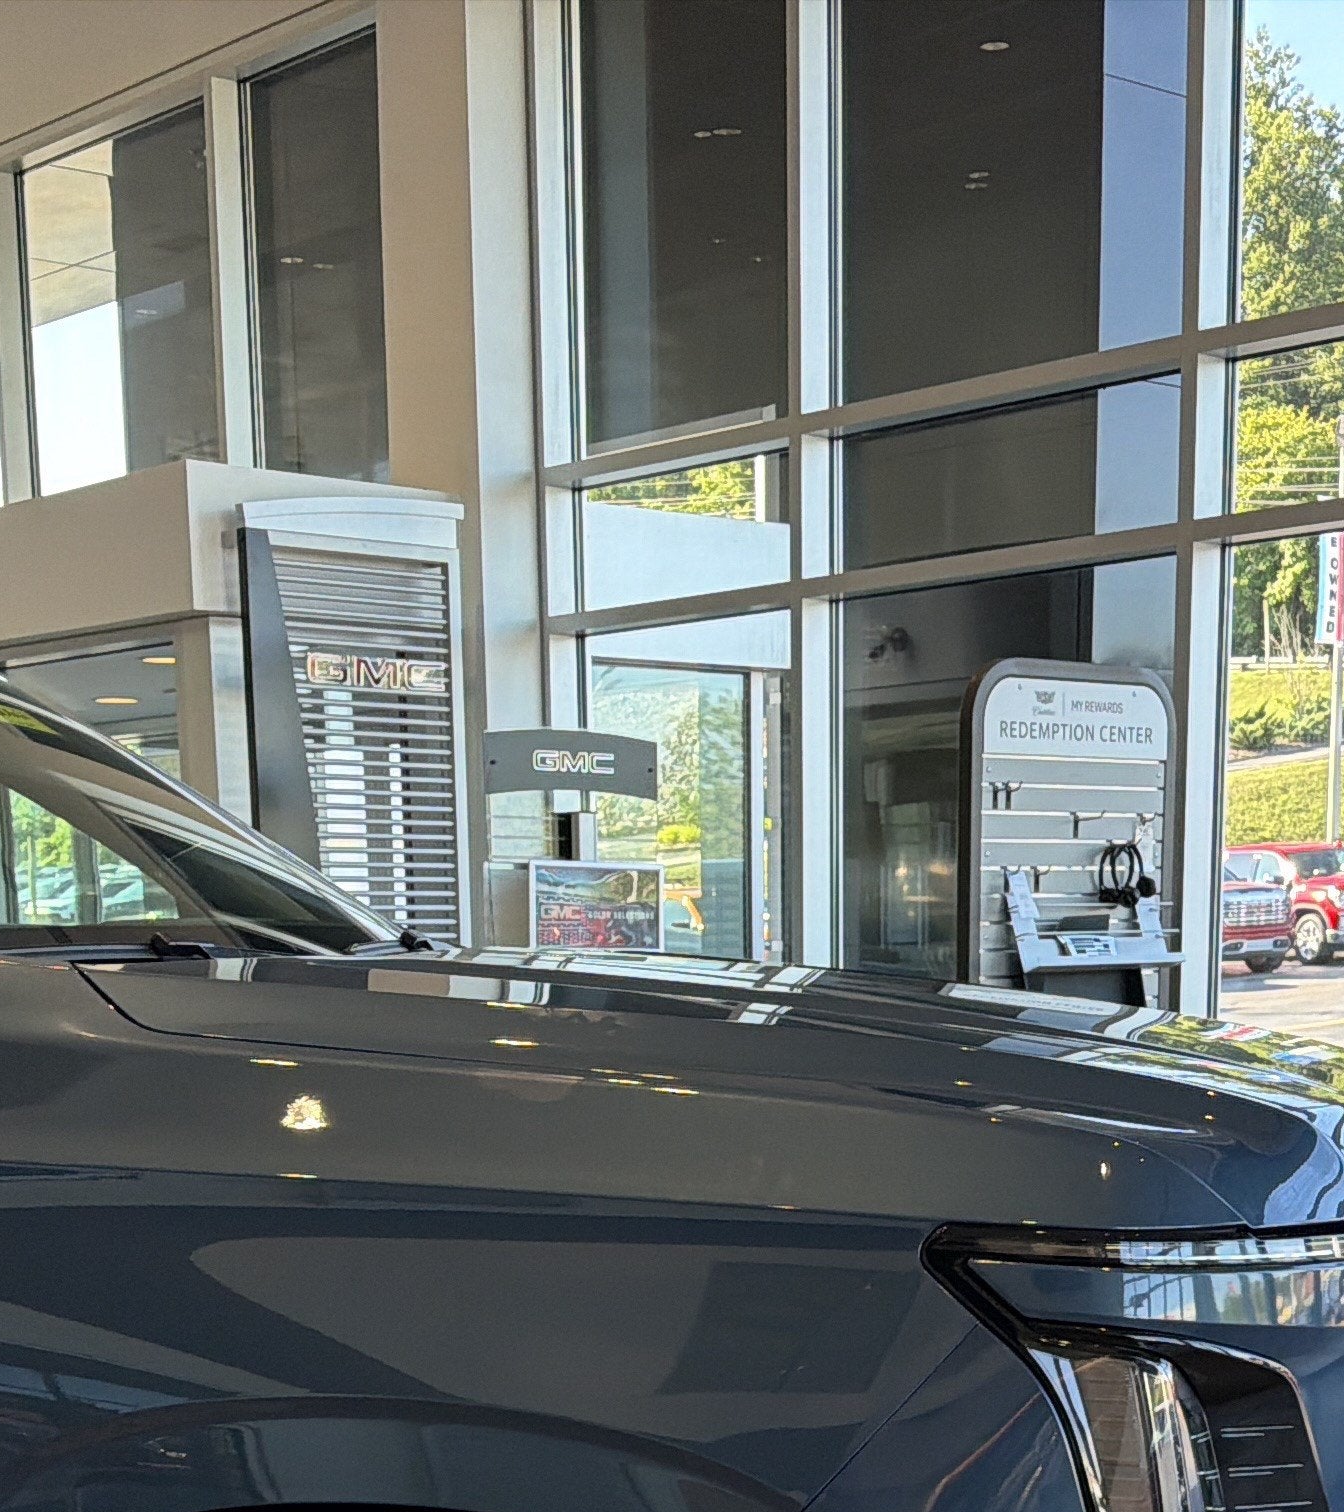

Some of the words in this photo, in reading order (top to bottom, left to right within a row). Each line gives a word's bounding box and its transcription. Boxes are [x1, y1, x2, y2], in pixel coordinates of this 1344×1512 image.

[1326, 558, 1339, 633] OWNED
[306, 652, 448, 691] GMC
[1071, 700, 1083, 711] MY
[1084, 701, 1123, 714] REWARDS
[999, 720, 1095, 741] REDEMPTION
[1099, 725, 1153, 744] CENTER
[533, 749, 614, 774] GMC
[540, 905, 582, 920] GMC
